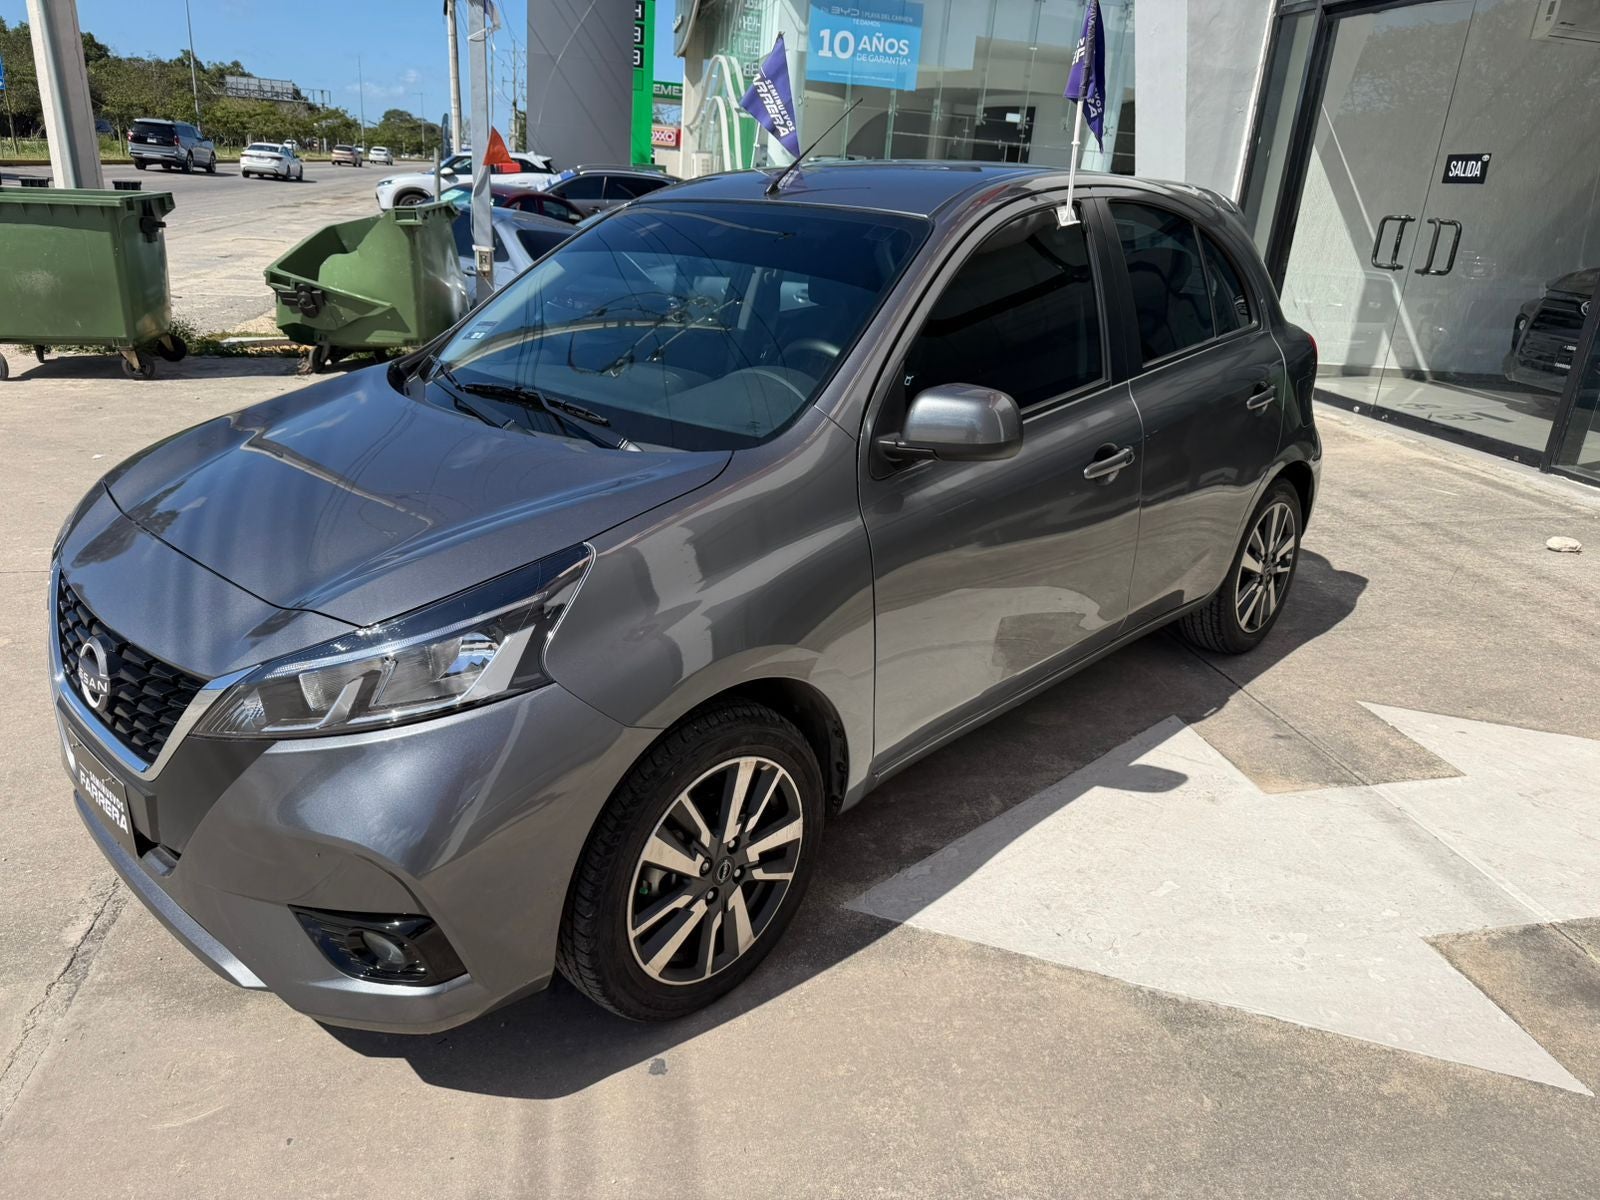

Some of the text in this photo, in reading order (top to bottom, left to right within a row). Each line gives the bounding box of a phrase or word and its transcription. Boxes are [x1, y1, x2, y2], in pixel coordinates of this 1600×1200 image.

[831, 6, 860, 16] BYD
[818, 28, 909, 59] 10 AÑOS
[856, 53, 867, 62] DE
[653, 84, 683, 96] EME
[752, 73, 790, 137] ARRERA
[764, 79, 796, 132] SEMINUEVOS
[1449, 160, 1482, 177] SALIDA
[79, 768, 129, 834] FARRERA
